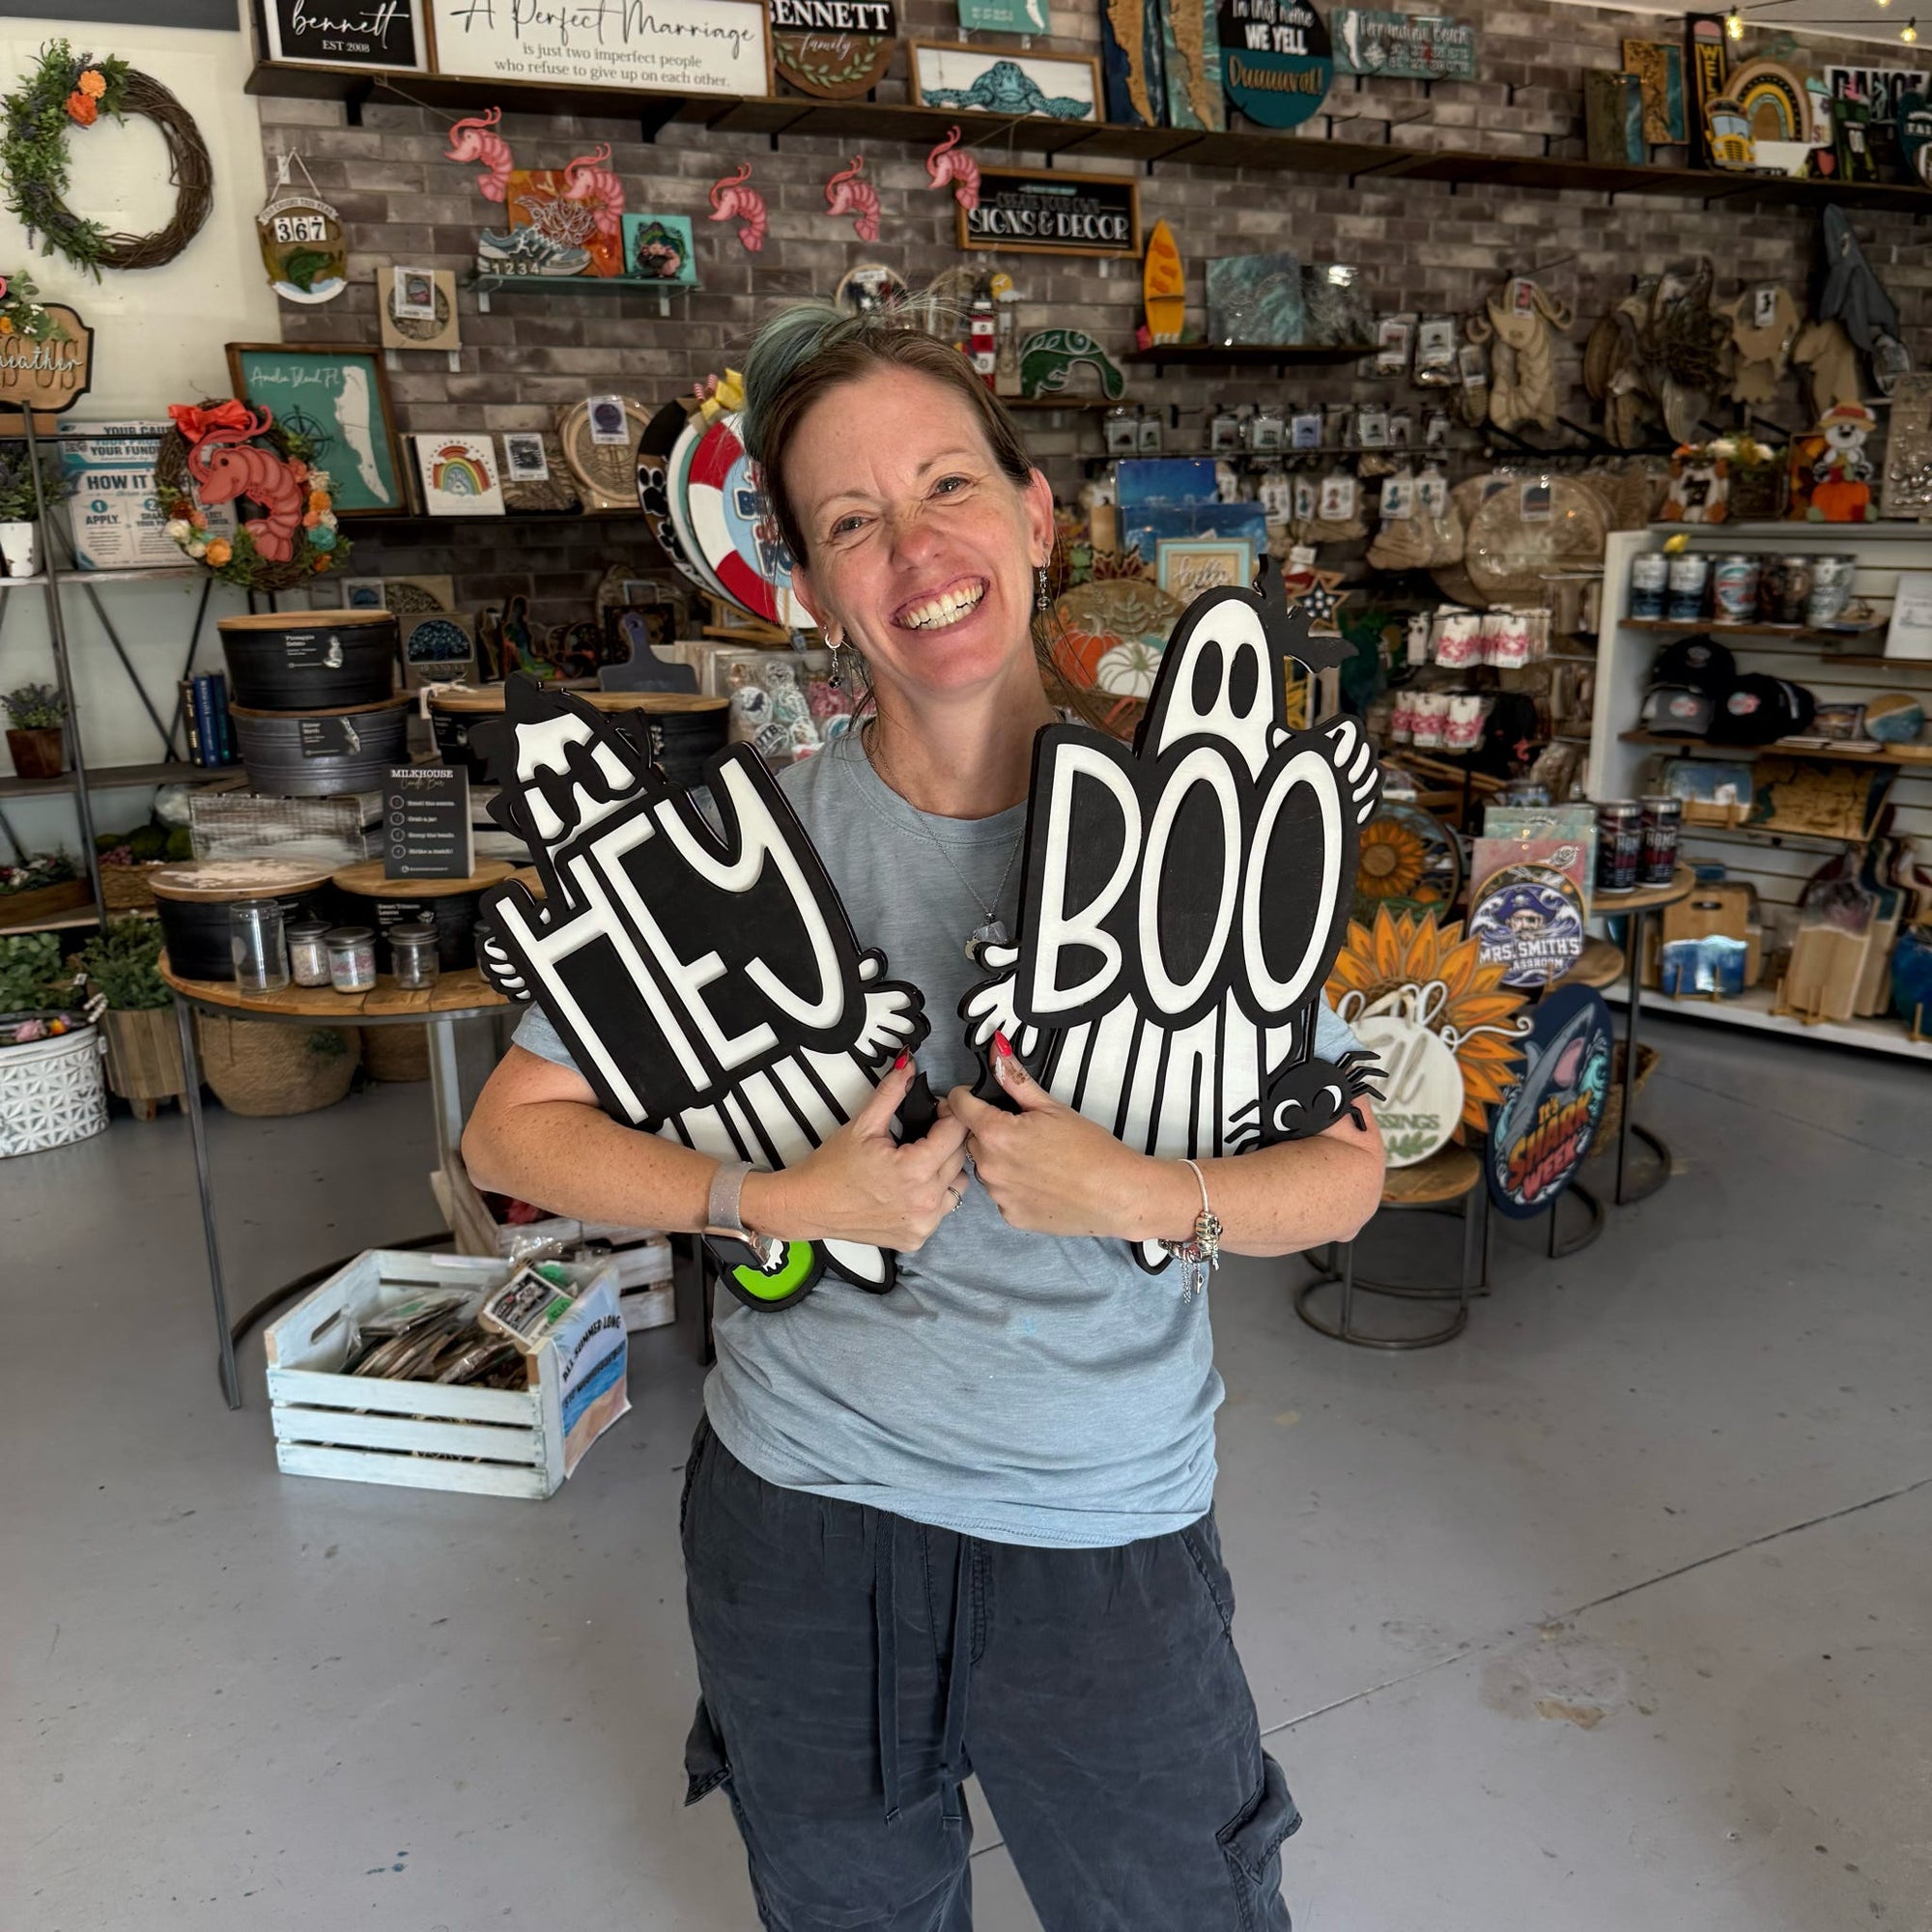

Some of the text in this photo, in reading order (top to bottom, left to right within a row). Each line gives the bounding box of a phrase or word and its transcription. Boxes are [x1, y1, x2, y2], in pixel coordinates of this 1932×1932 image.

[293, 0, 411, 49] bennett
[450, 0, 755, 60] A Perfect Marriage
[770, 0, 890, 31] ENNETT
[323, 40, 371, 53] EST 2008
[786, 32, 863, 63] family
[1244, 24, 1308, 55] WE YELL
[523, 43, 702, 70] is just two imperfect people
[1700, 44, 1719, 94] WEL
[495, 58, 730, 88] who refuse to give up on each other.
[277, 221, 323, 242] 367
[969, 208, 1129, 241] SIGNS & DECOR
[90, 446, 124, 457] YOUR
[87, 475, 148, 491] HOW IT
[391, 769, 454, 779] MILKHOUSE
[1027, 742, 1345, 1015] BOO
[496, 757, 846, 1126] HEY
[1479, 936, 1580, 964] MRS. SMITH'S
[1508, 957, 1564, 972] ASSROOM
[1377, 1113, 1440, 1130] SSINGS
[1507, 1088, 1593, 1191] SHARK
[575, 1319, 603, 1359] SUMMER
[603, 1315, 622, 1329] LONG
